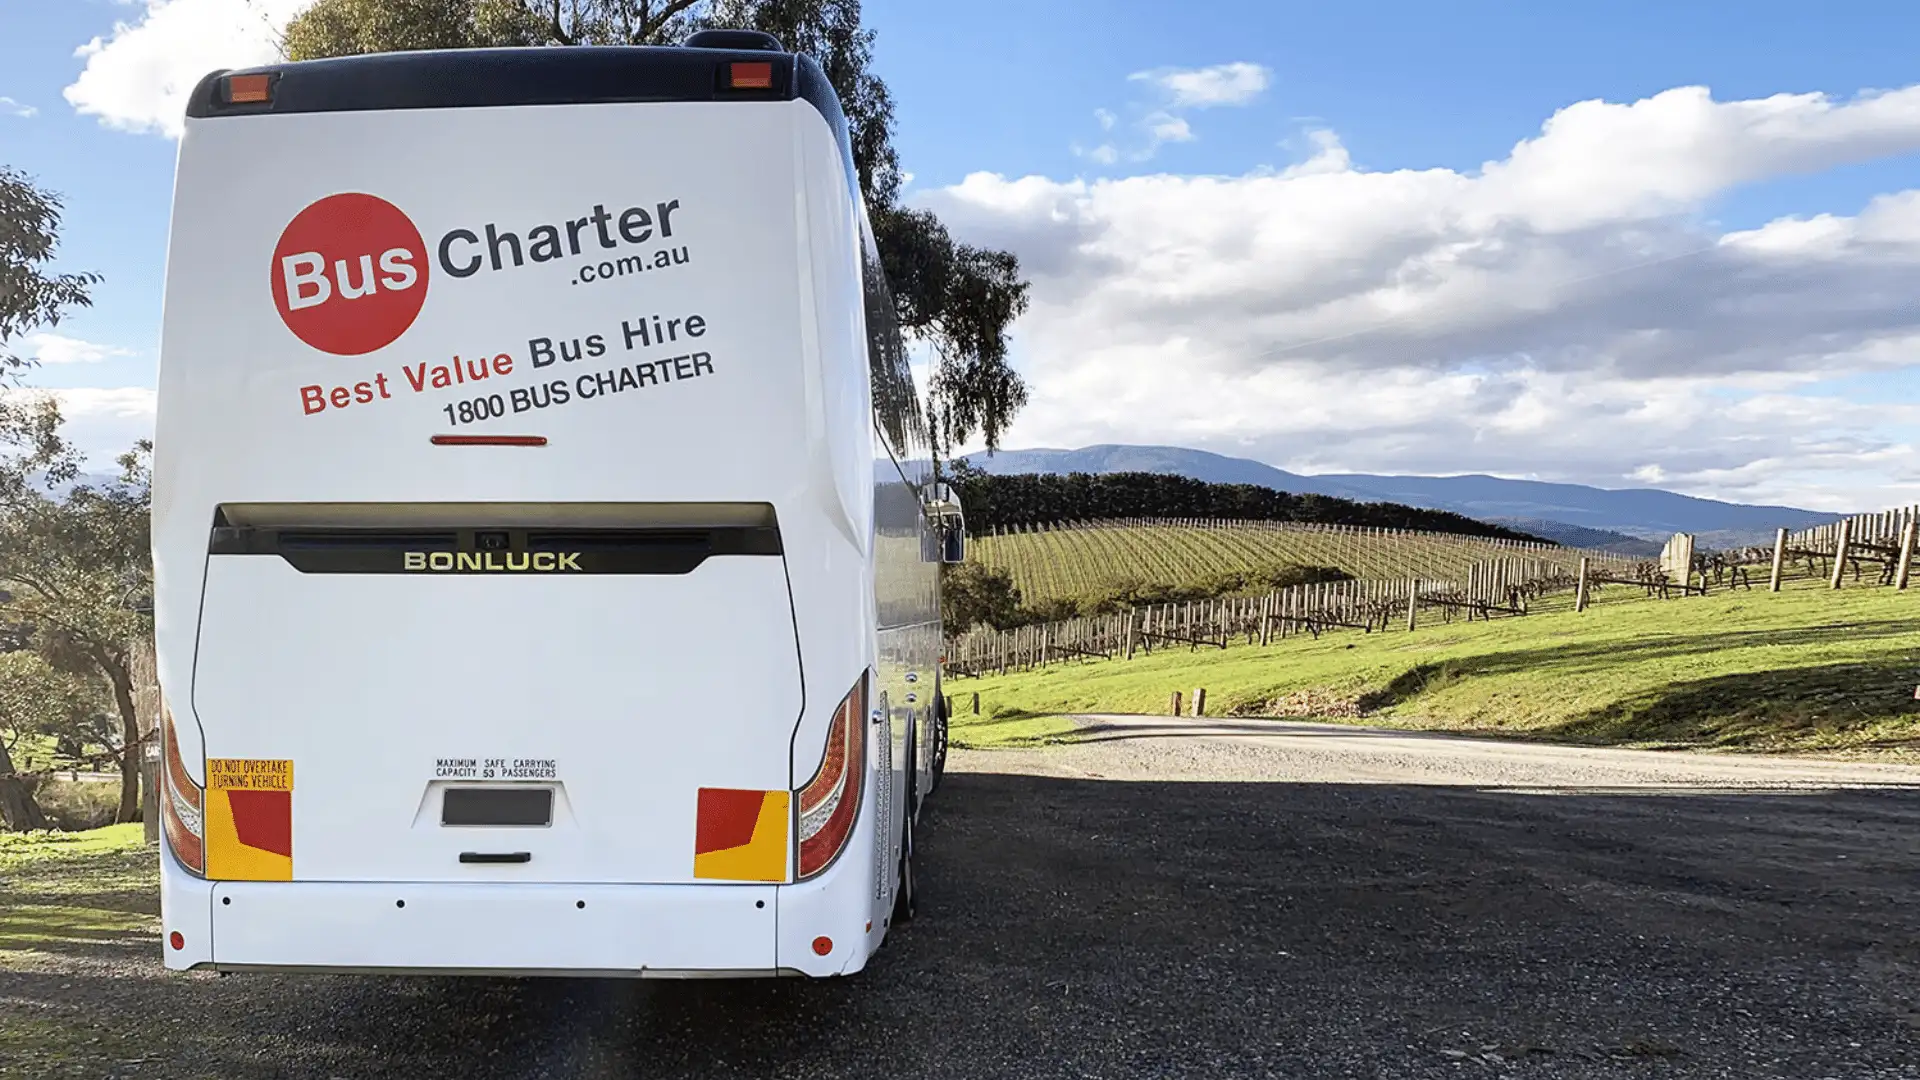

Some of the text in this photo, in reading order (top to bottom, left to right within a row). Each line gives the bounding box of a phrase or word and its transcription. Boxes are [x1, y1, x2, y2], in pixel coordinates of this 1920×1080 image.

[282, 199, 680, 311] Bus Charter
[571, 246, 690, 285] .com.au
[300, 314, 707, 416] Best Value Bus Hire
[442, 351, 715, 427] 1800 BUS CHARTER
[403, 551, 583, 571] BONLUCK
[211, 760, 288, 774] DO NOT OVERTAKE
[436, 759, 556, 769] MAXIMUM SAFE CARRYING
[436, 768, 556, 778] CAPACITY 53 PASSENGERS
[213, 774, 288, 789] TURNING VEHICLE
